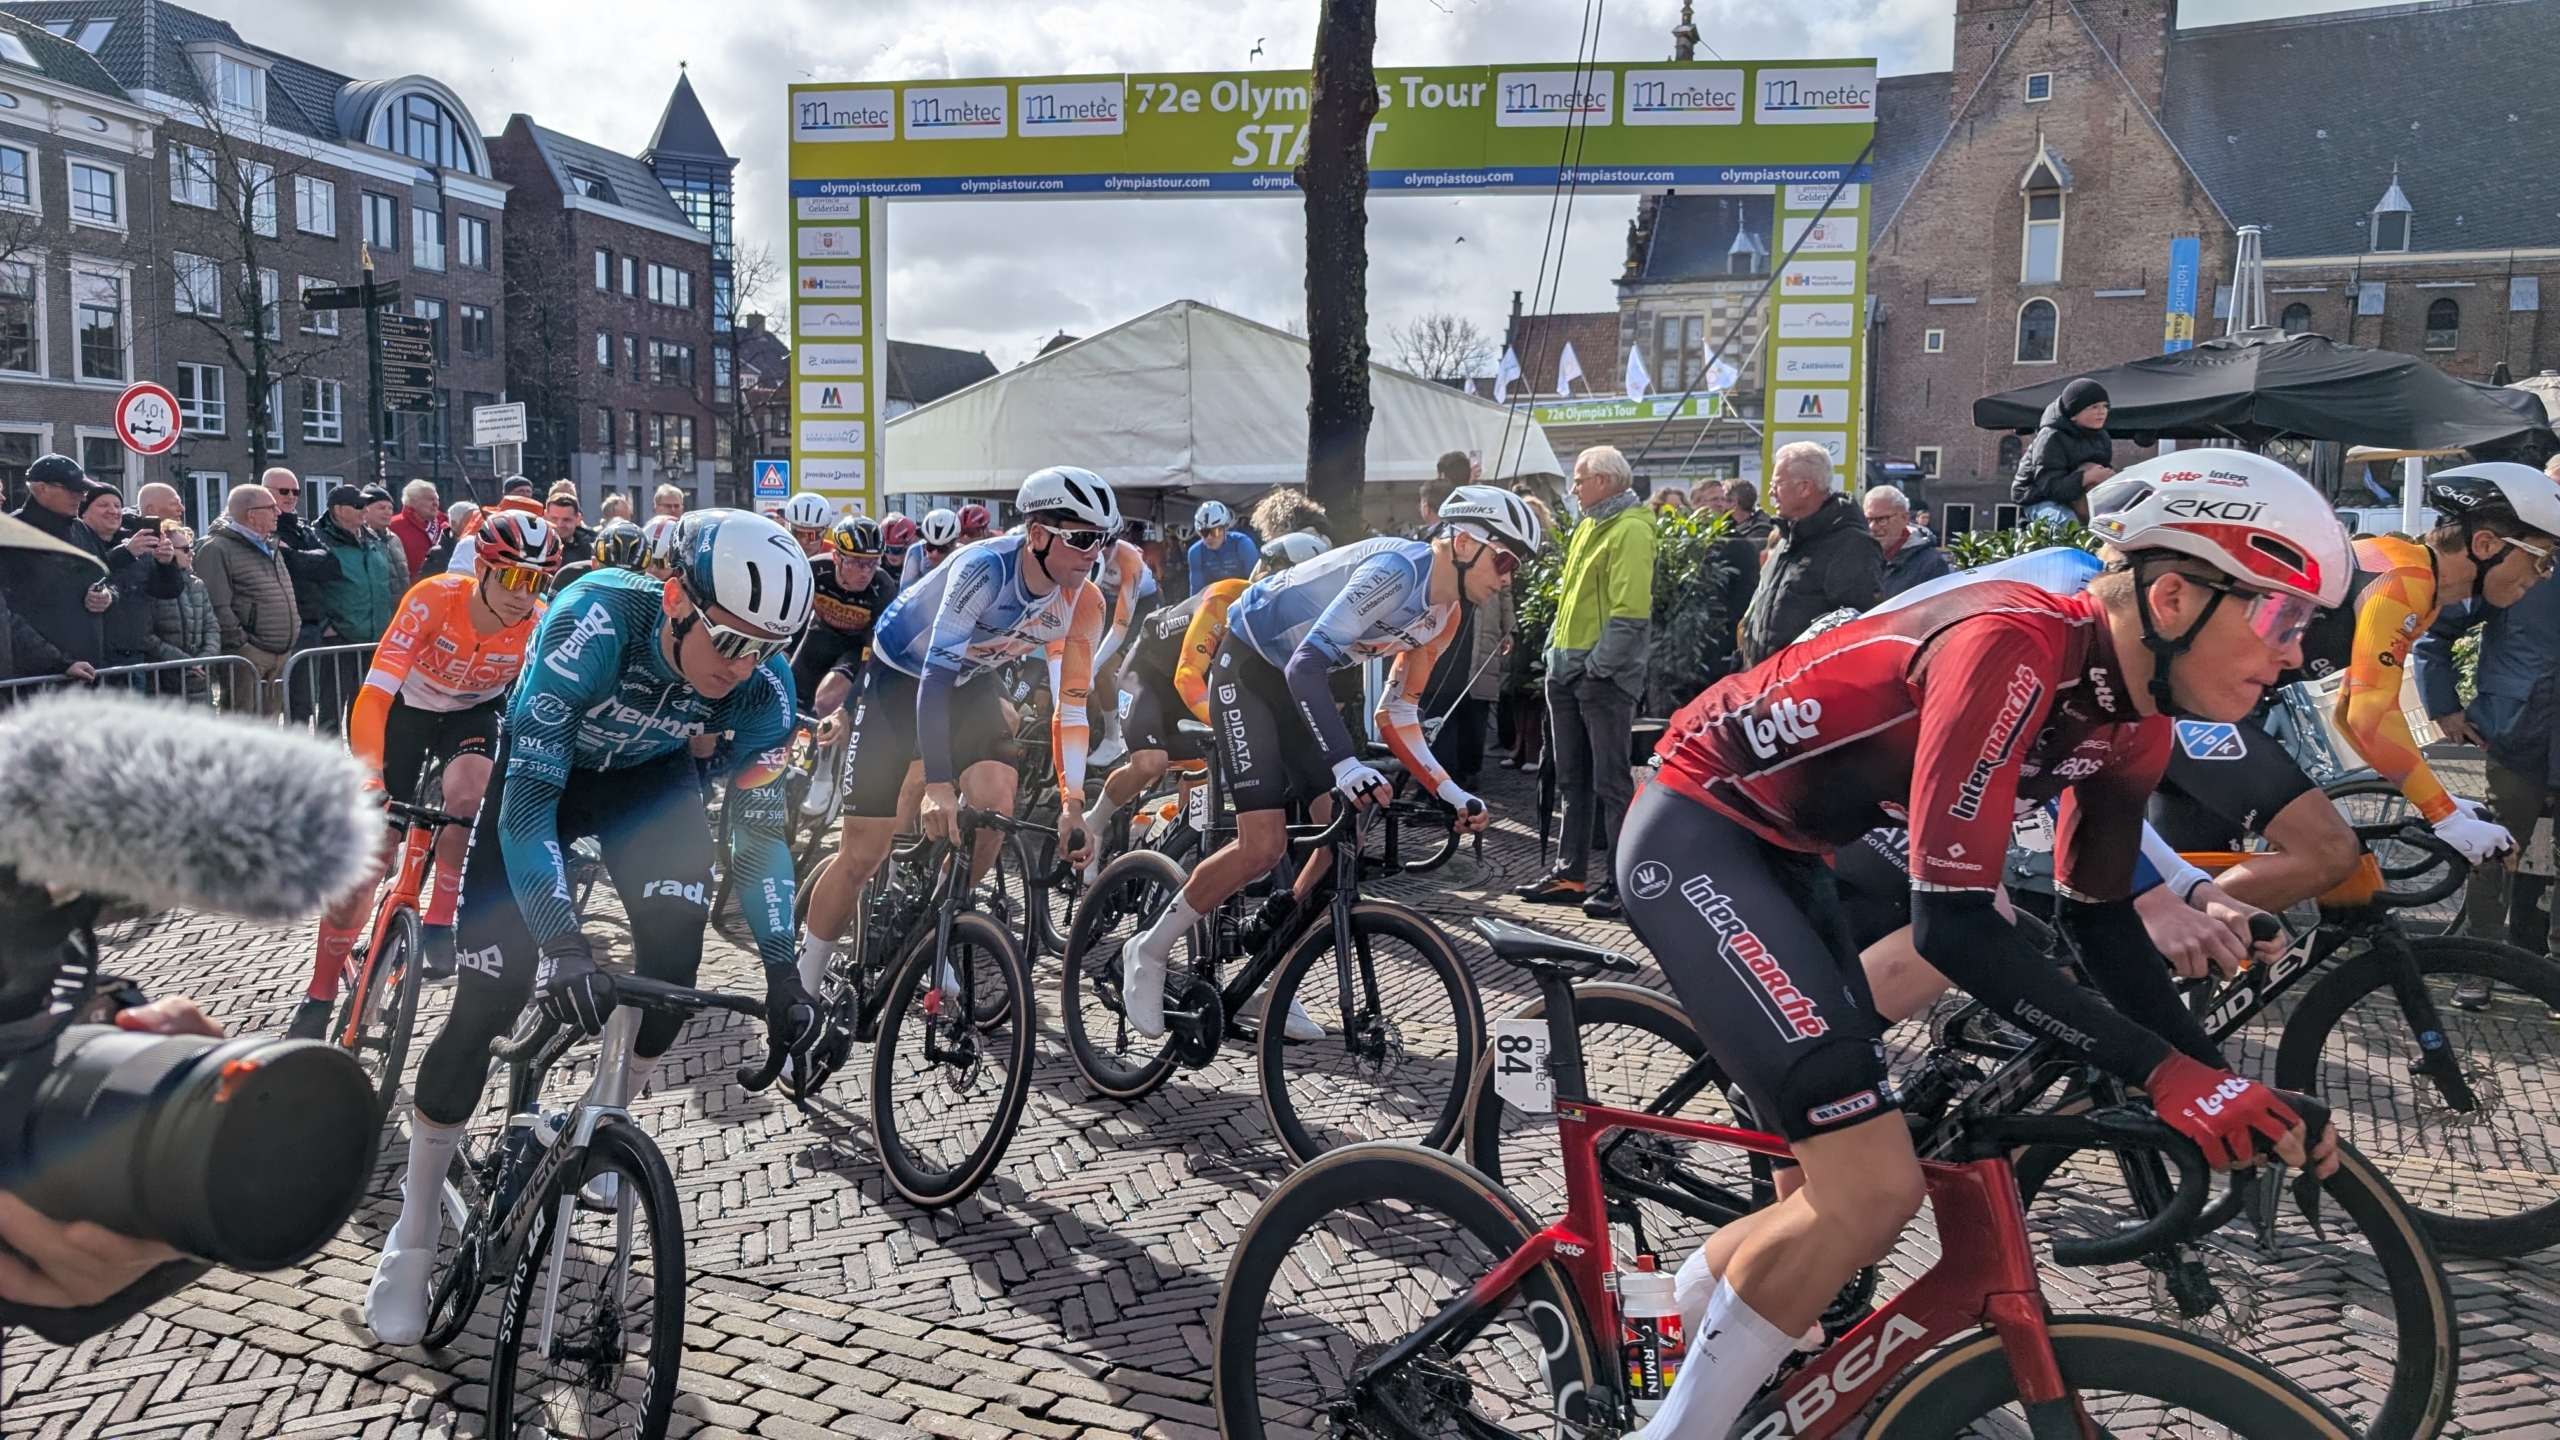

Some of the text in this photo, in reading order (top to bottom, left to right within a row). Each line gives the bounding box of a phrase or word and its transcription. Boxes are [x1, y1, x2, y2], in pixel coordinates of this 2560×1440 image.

[1135, 83, 1200, 113] 72e
[1400, 76, 1486, 108] Tour
[1542, 89, 1606, 109] metec
[1671, 87, 1736, 107] metec
[1803, 85, 1871, 106] metec
[833, 108, 889, 126] metec
[944, 102, 1001, 122] metec
[1059, 100, 1118, 120] metec
[1104, 175, 1210, 190] olympiastour.com
[1560, 167, 1675, 184] olympiastour.com
[1720, 166, 1840, 182] olympiastour.com
[820, 181, 922, 195] olympiastour.com
[961, 177, 1064, 192] olympiastour.com
[808, 204, 849, 213] Gelderland
[820, 357, 858, 365] Zaltbommel
[1547, 405, 1637, 421] 72e Olympia's Tour
[1022, 496, 1065, 510] S-WORKS
[1442, 506, 1496, 516] S-WORKS
[954, 573, 991, 615] Lichtenvoorde
[1357, 583, 1403, 617] Lichtenvoorde
[380, 596, 430, 670] INEOS
[436, 637, 457, 653] GOBIK
[1743, 698, 1822, 760] Lotto
[518, 736, 545, 750] SVL
[1222, 711, 1240, 775] bedrijfssoftware
[1228, 708, 1253, 774] DIDATA
[528, 761, 566, 779] SWISS
[752, 788, 777, 798] SVL
[1190, 788, 1204, 821] 231
[2039, 807, 2053, 840] metec
[1926, 855, 1982, 871] TECHNORD
[1637, 878, 1667, 895] vermarc
[762, 877, 783, 933] rad-net
[1679, 873, 1831, 1039] Intermarché
[2011, 997, 2098, 1053] vermarc
[1497, 1034, 1532, 1076] 84
[1535, 1038, 1547, 1091] metec
[1815, 1094, 1871, 1120] WANTY
[1554, 1240, 1585, 1257] Lotto
[500, 1254, 528, 1344] SWISS
